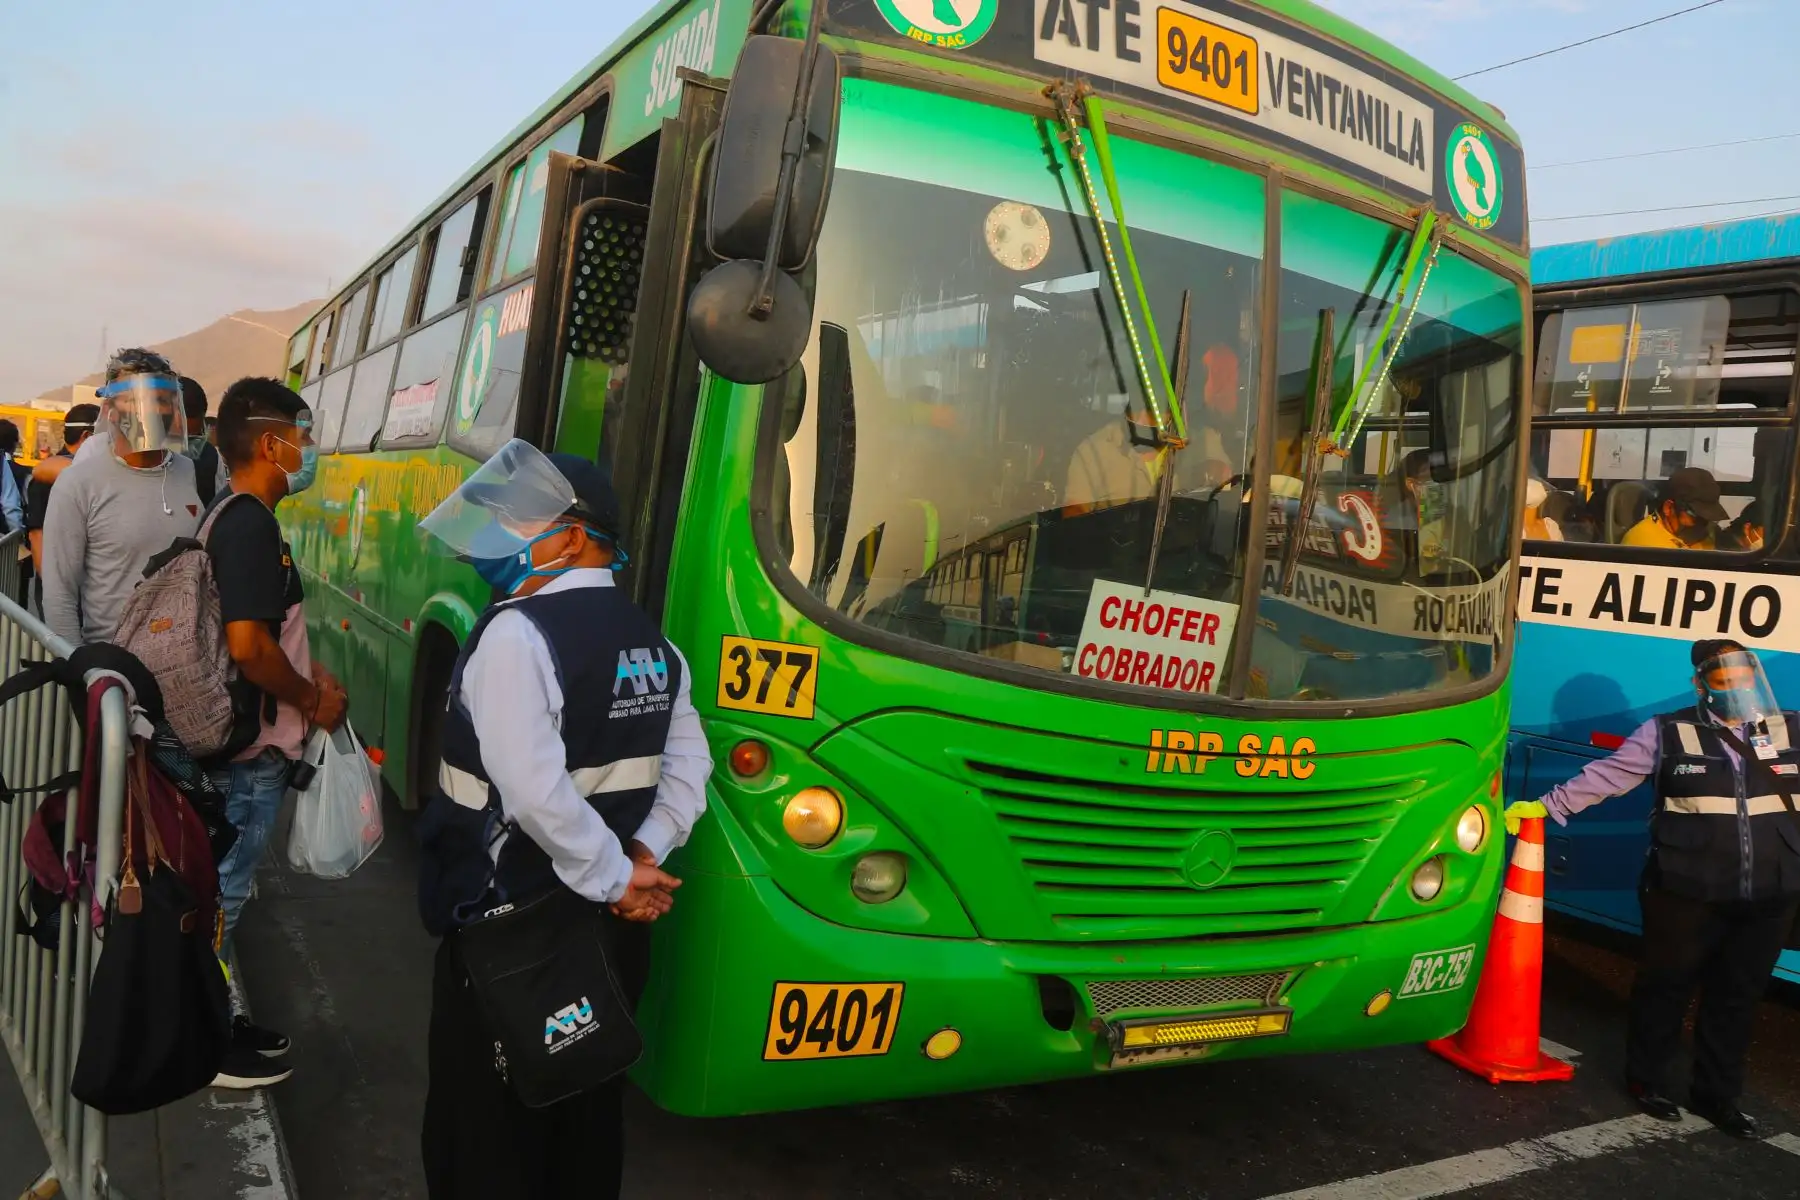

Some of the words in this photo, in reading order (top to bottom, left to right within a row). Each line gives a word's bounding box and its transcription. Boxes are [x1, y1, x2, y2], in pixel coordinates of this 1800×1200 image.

[645, 0, 720, 117] SUBIDA
[907, 25, 933, 44] IRP
[936, 33, 966, 48] SAC
[1040, 0, 1142, 63] ATE
[1167, 26, 1249, 96] 9401
[1265, 51, 1426, 172] VENTANILLA
[1099, 595, 1221, 646] CHOFER
[1588, 572, 1781, 638] ALIPIO
[612, 646, 669, 698] ATU
[724, 645, 813, 708] 377
[1077, 642, 1216, 694] COBRADOR
[1145, 729, 1225, 775] IRP
[1235, 733, 1317, 780] SAC
[1402, 949, 1474, 994] B3C-752
[544, 995, 593, 1045] ATU
[775, 987, 895, 1055] 9401
